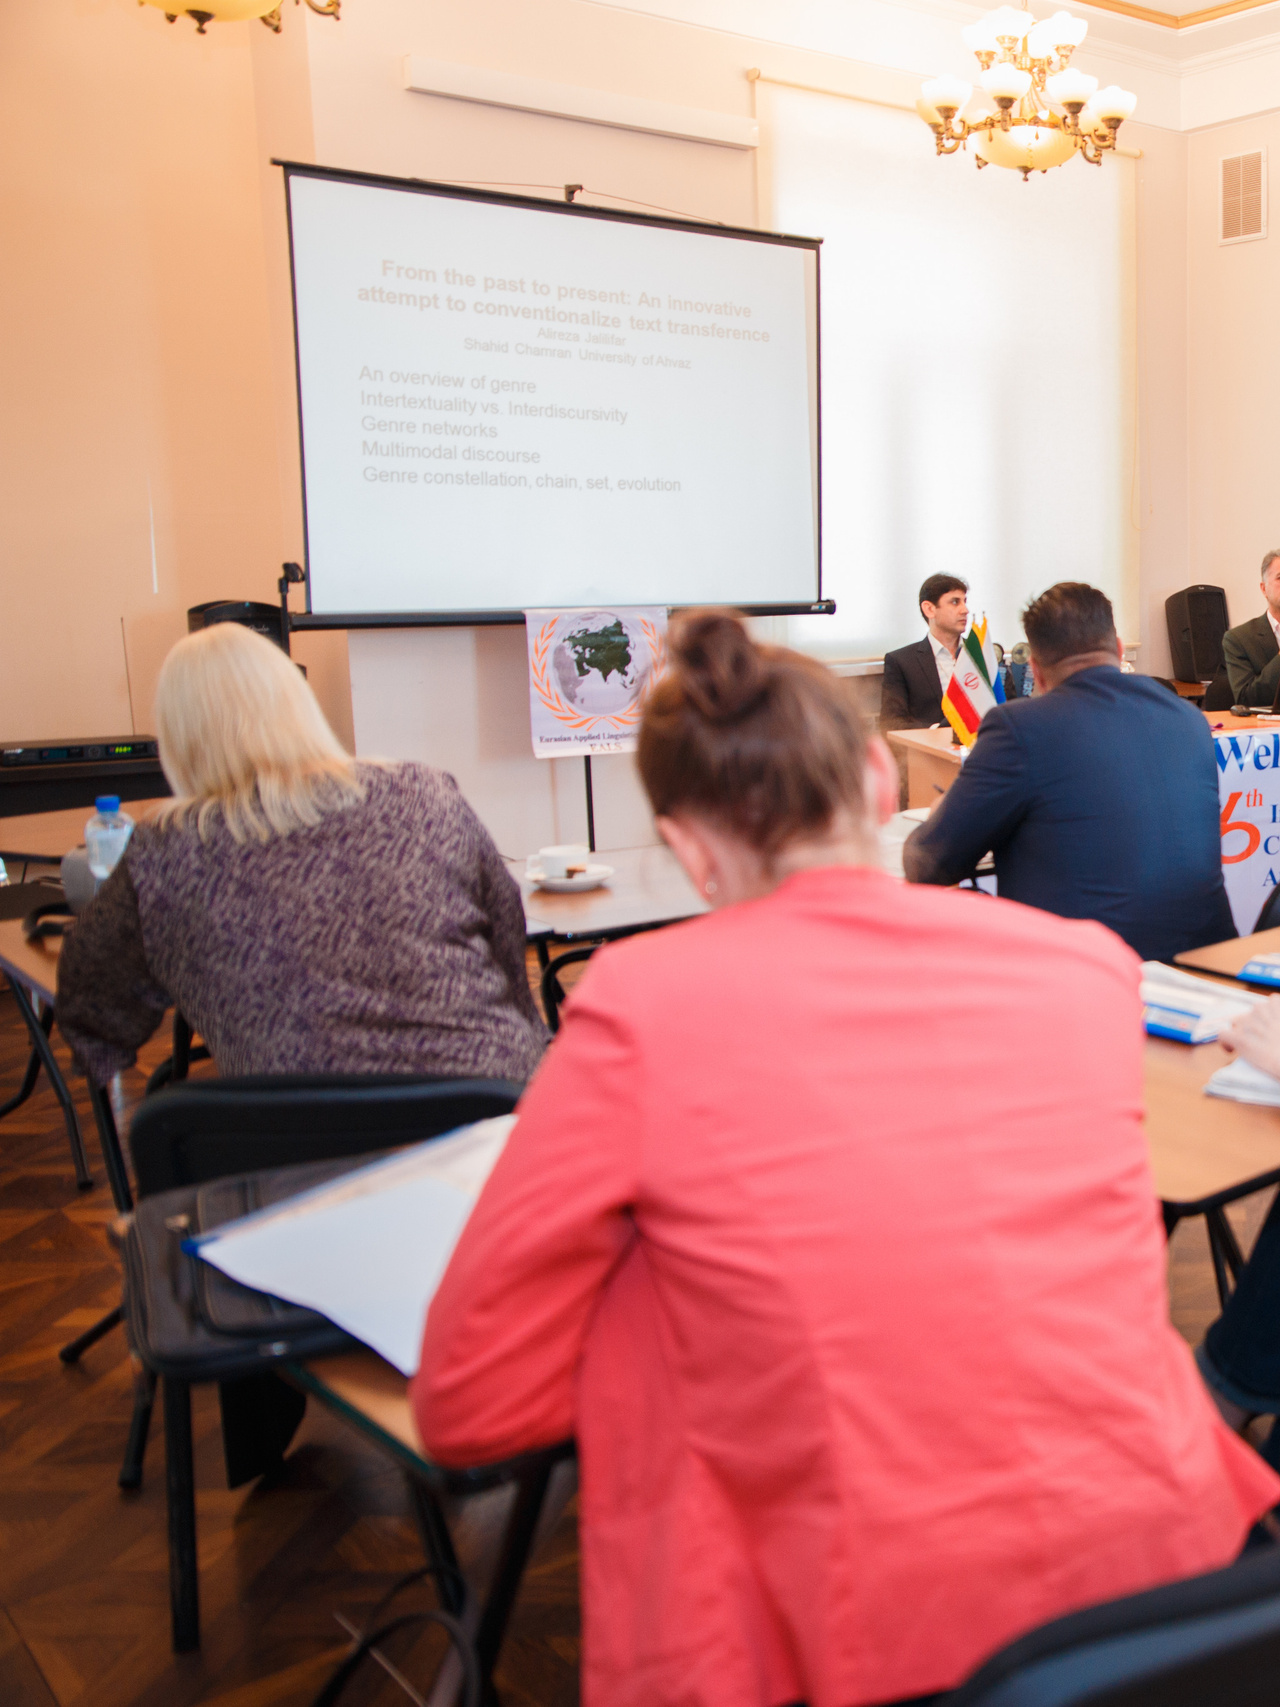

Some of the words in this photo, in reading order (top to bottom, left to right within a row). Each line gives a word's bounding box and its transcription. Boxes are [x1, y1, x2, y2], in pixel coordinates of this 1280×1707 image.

[381, 259, 437, 283] From
[444, 268, 476, 287] the
[484, 275, 526, 293] past
[532, 280, 551, 296] to
[557, 285, 631, 306] present:
[638, 291, 661, 308] An
[667, 294, 752, 318] innovative
[358, 286, 440, 311] attempt
[446, 295, 466, 312] to
[473, 301, 622, 328] conventionalize
[629, 315, 662, 333] text
[667, 320, 771, 342] transference
[537, 327, 580, 342] Alireza
[463, 338, 509, 354] Shahid
[514, 342, 572, 359] Chamran
[578, 348, 637, 367] University
[642, 354, 655, 366] of
[656, 355, 692, 369] Ahvaz
[359, 366, 384, 382] An
[389, 370, 465, 389] overview
[471, 375, 487, 390] of
[491, 378, 537, 394] genre
[361, 390, 477, 416] Intertextuality
[481, 402, 503, 415] vs.
[508, 401, 628, 425] Interdiscursivity
[361, 416, 416, 434] Genre
[422, 420, 498, 438] networks
[362, 440, 457, 460] Multimodal
[462, 445, 541, 464] discourse
[363, 466, 418, 483] Genre
[423, 470, 532, 490] constellation,
[536, 473, 582, 492] chain,
[586, 475, 613, 492] set,
[617, 477, 682, 492] evolution
[589, 742, 623, 752] EALS
